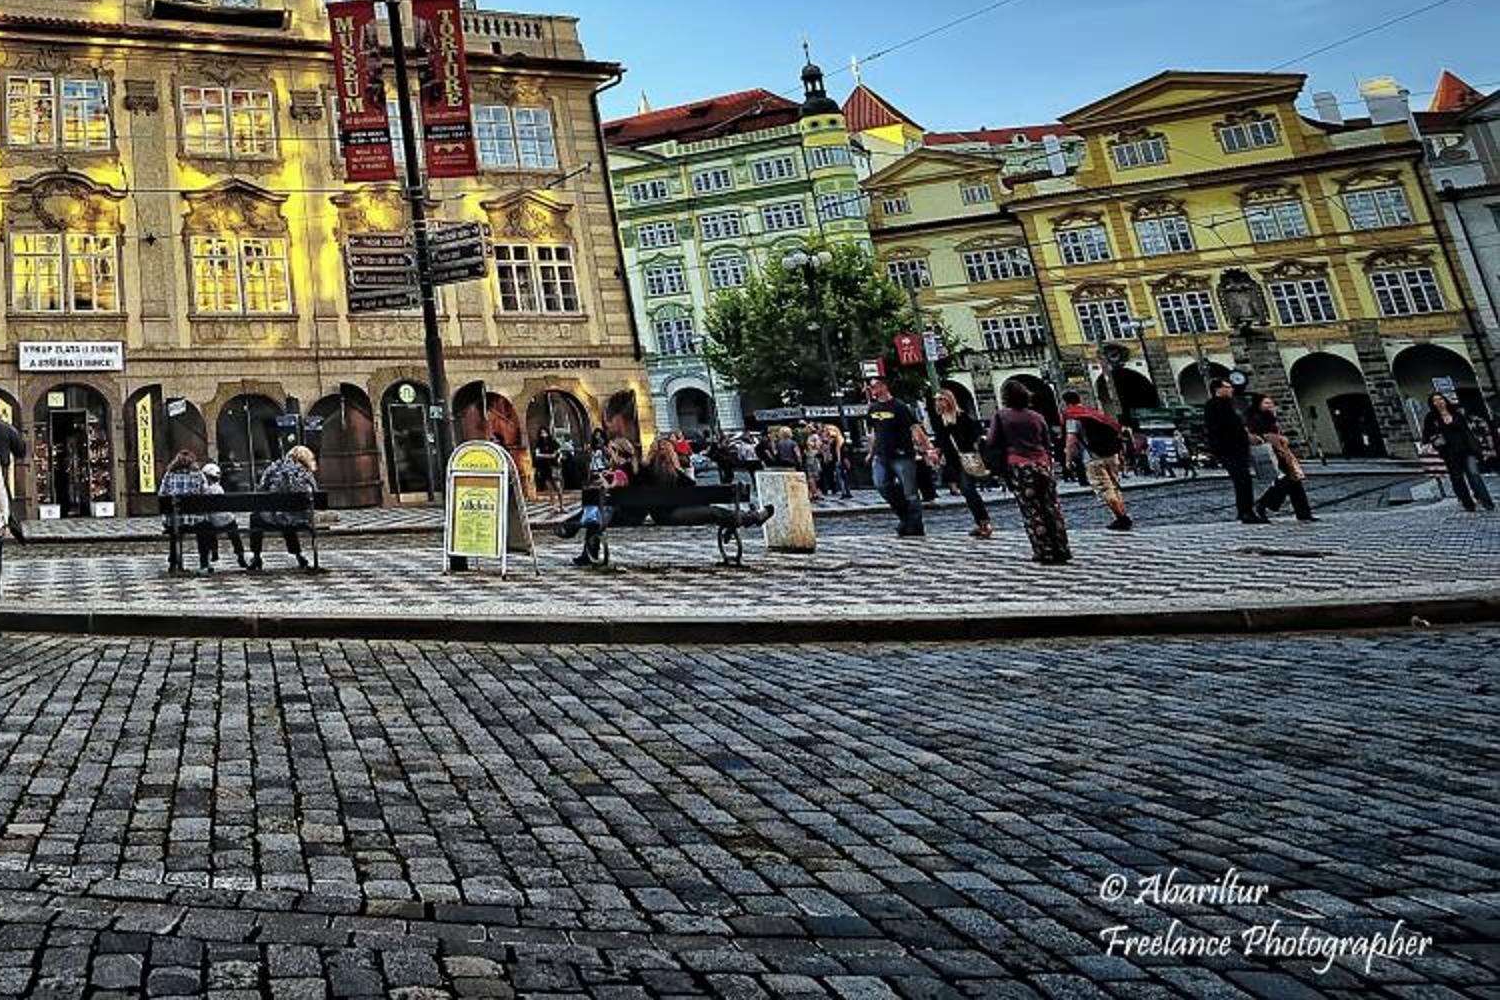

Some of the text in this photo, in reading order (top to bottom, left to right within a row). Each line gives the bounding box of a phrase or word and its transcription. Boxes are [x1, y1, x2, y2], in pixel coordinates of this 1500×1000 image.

[333, 15, 365, 113] MUSEUM
[437, 9, 464, 107] TORTURE
[498, 359, 600, 370] STARBUCKS COFFEE
[140, 404, 152, 488] ANTIQUE
